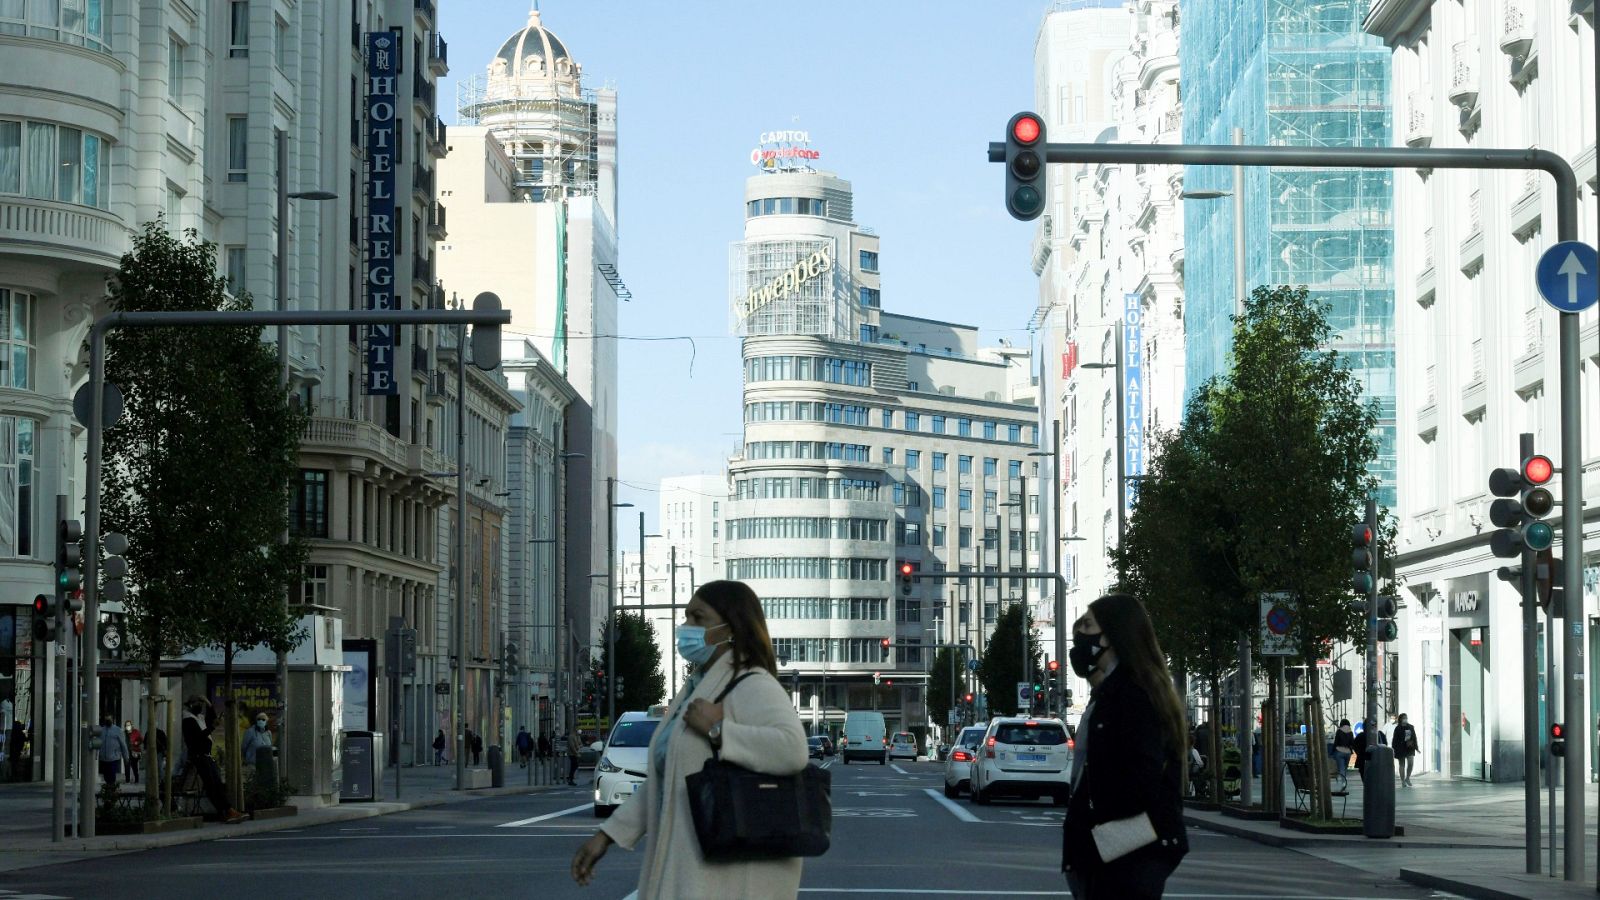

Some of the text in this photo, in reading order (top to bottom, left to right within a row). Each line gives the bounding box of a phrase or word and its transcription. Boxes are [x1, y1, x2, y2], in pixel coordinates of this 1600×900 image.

[760, 130, 811, 144] CAPITOL
[761, 146, 820, 159] vodafone
[368, 76, 394, 390] HOTEL REGENTE
[732, 245, 831, 330] Schweppes
[1126, 298, 1139, 368] HOTEL
[1454, 590, 1478, 613] MANGO
[215, 685, 270, 700] Eplota
